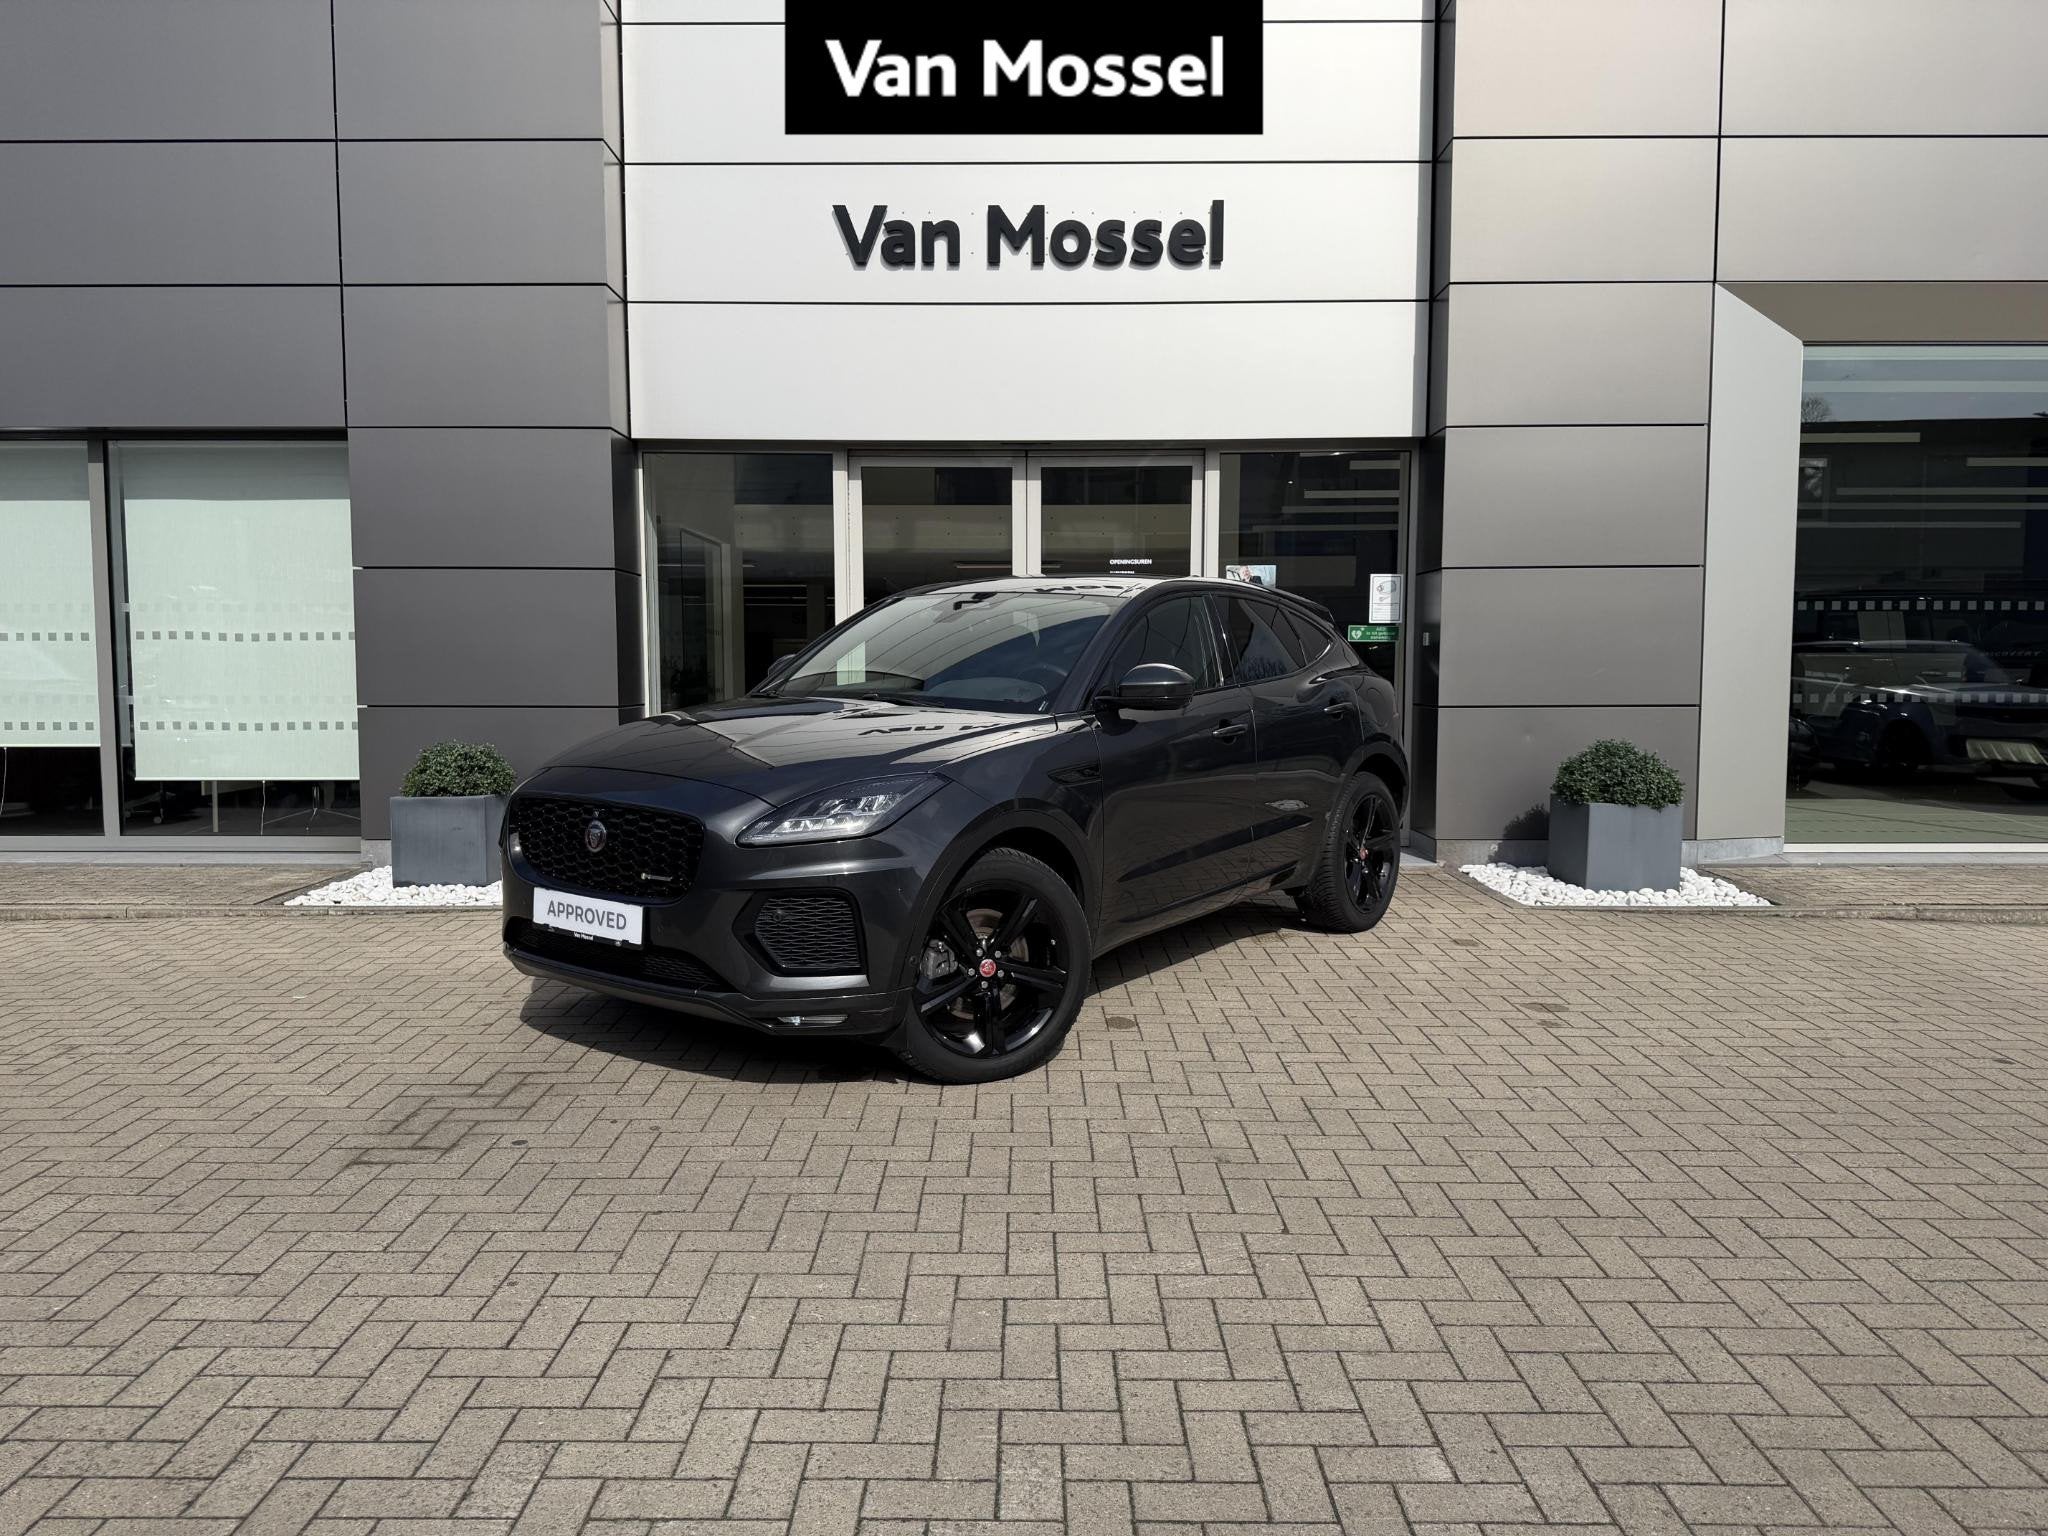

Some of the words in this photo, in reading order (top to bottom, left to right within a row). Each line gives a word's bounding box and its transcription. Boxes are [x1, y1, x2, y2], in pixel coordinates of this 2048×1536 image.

[832, 204, 961, 267] Van
[986, 200, 1225, 267] Mossel
[547, 900, 627, 930] APPROVED
